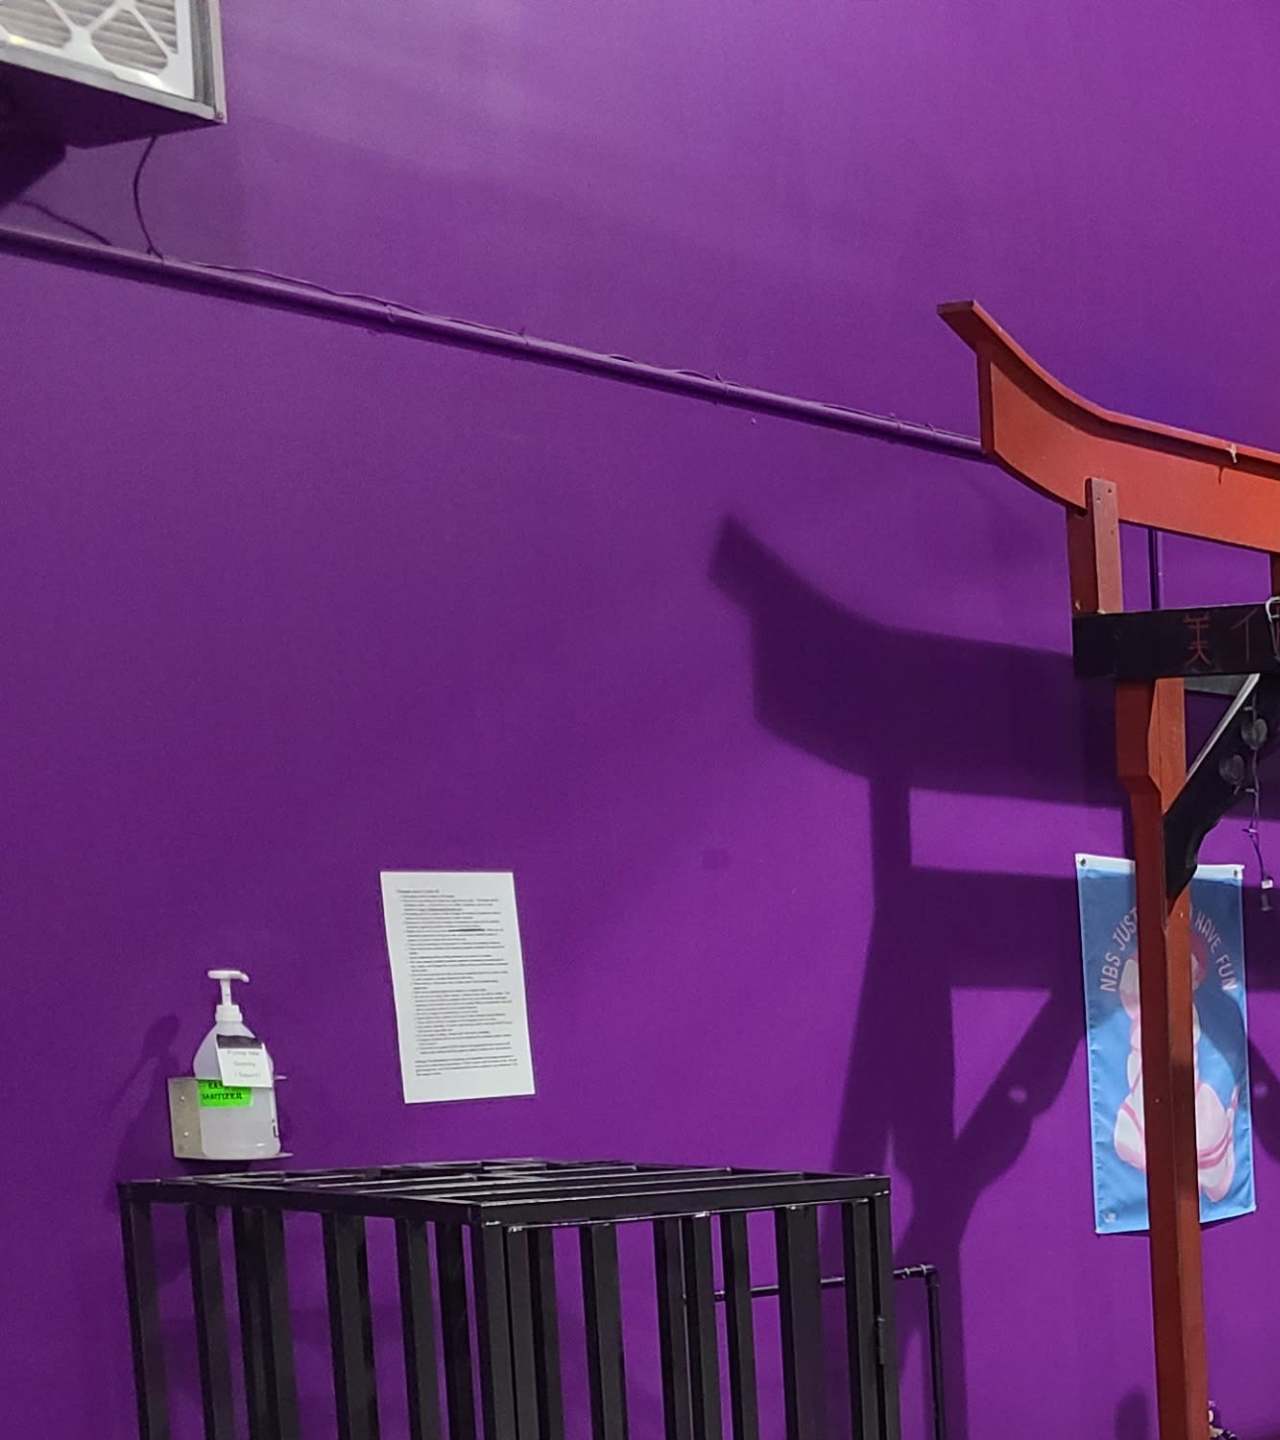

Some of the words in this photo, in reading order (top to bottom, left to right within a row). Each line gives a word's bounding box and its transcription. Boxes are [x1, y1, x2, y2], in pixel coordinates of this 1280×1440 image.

[1100, 951, 1121, 993] NBS
[1195, 912, 1222, 954] HAVE
[1216, 954, 1238, 991] FUN
